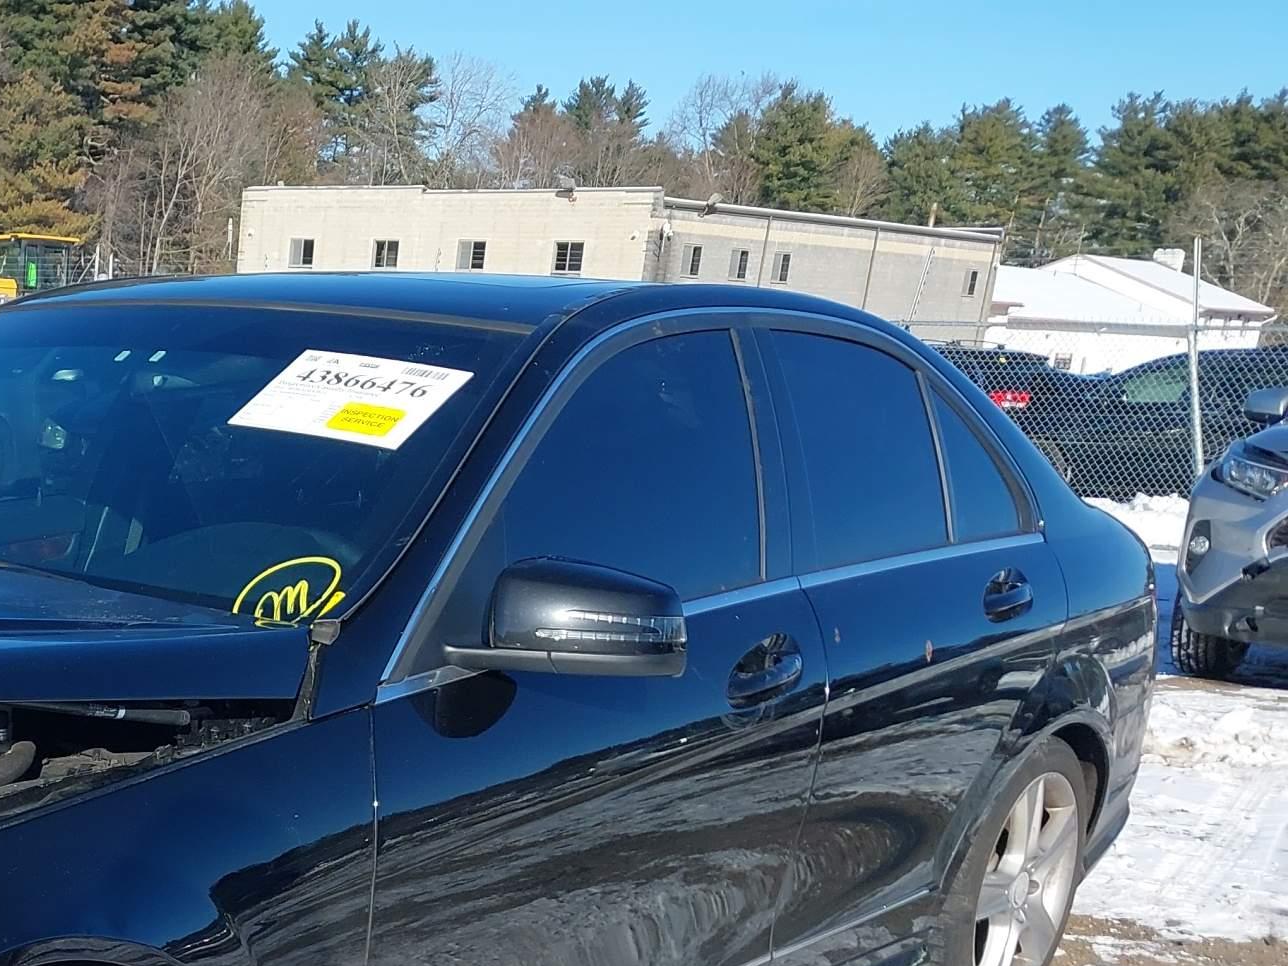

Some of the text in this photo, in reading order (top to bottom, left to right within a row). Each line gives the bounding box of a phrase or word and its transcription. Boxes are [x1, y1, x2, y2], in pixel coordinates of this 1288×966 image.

[296, 367, 433, 398] 43866476
[340, 408, 400, 422] INSPECTION
[340, 416, 386, 428] SERVICE
